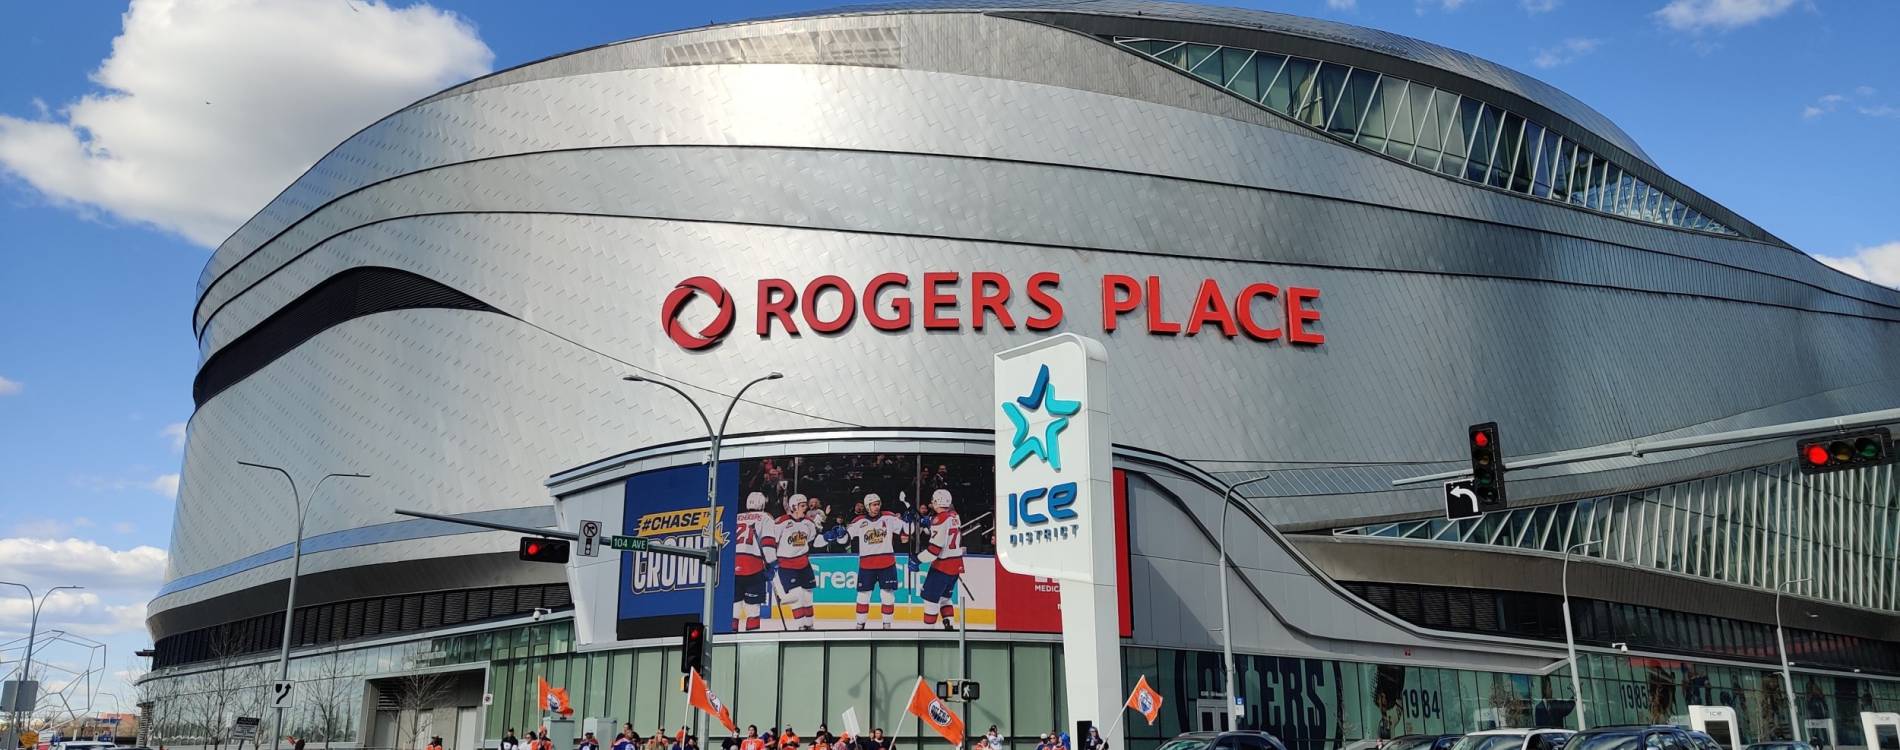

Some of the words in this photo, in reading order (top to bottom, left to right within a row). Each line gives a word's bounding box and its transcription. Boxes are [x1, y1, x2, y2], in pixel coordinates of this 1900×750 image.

[756, 271, 1063, 336] ROGERS
[1102, 274, 1325, 344] PLACE
[641, 511, 701, 531] #CHASE
[614, 538, 628, 547] 104
[631, 540, 646, 550] AVE
[736, 523, 756, 546] 21
[948, 528, 960, 549] 7
[1010, 525, 1079, 548] DISTRICT
[812, 563, 858, 588] rea
[896, 563, 930, 597] lip
[1034, 584, 1061, 593] MEDIC
[1197, 651, 1327, 750] OLERS
[1402, 689, 1441, 720] 1984
[1620, 683, 1648, 710] 1985
